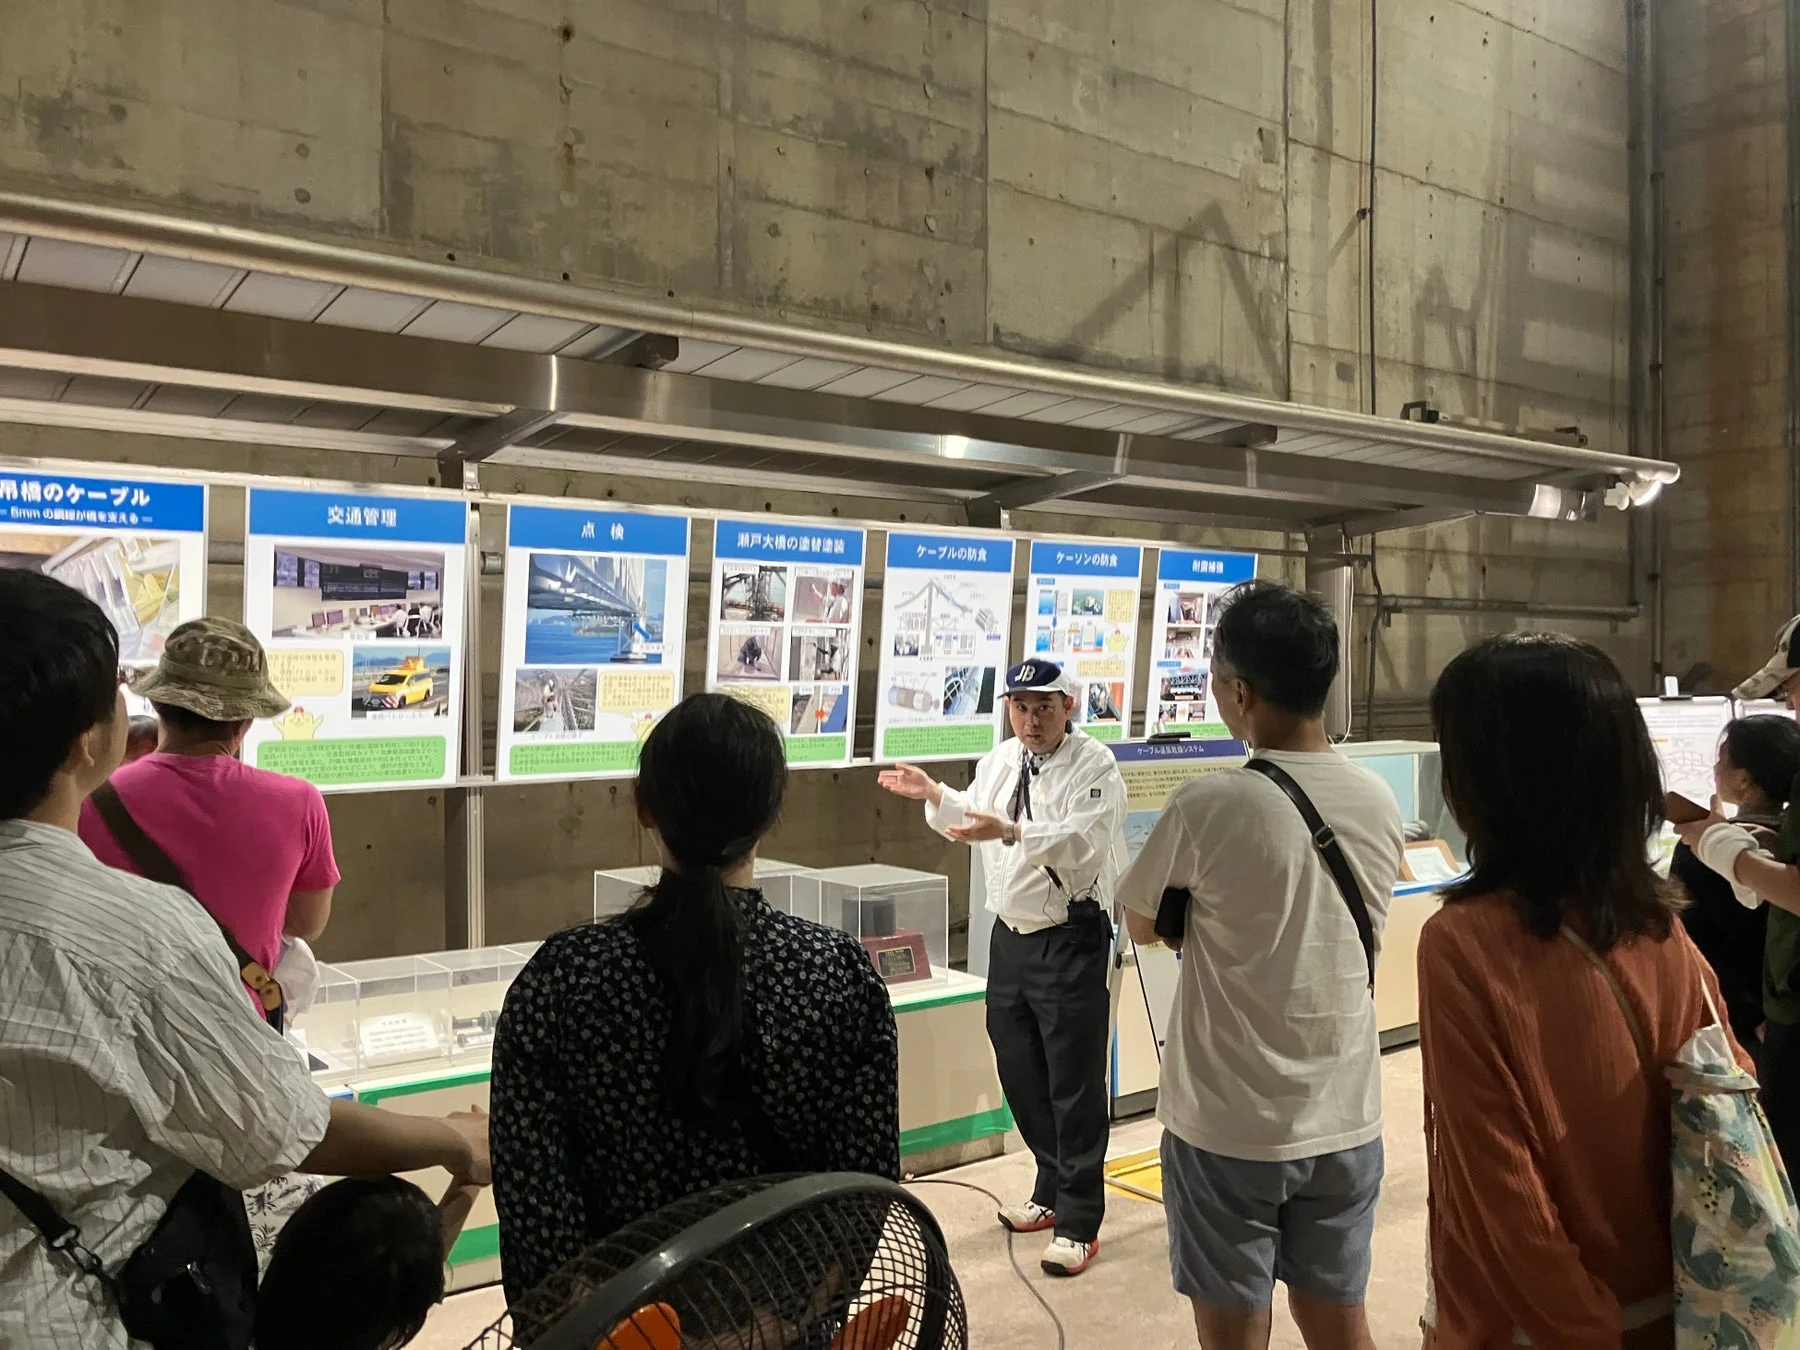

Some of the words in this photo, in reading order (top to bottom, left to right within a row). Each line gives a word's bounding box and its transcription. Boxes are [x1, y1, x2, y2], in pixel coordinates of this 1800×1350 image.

[327, 504, 398, 528] 交通管理
[737, 532, 846, 554] 瀬戸大橋の塗替塗装
[916, 544, 988, 563] ケーブルの防食
[1056, 551, 1119, 568] ケーソンの防食
[1014, 664, 1036, 682] JB
